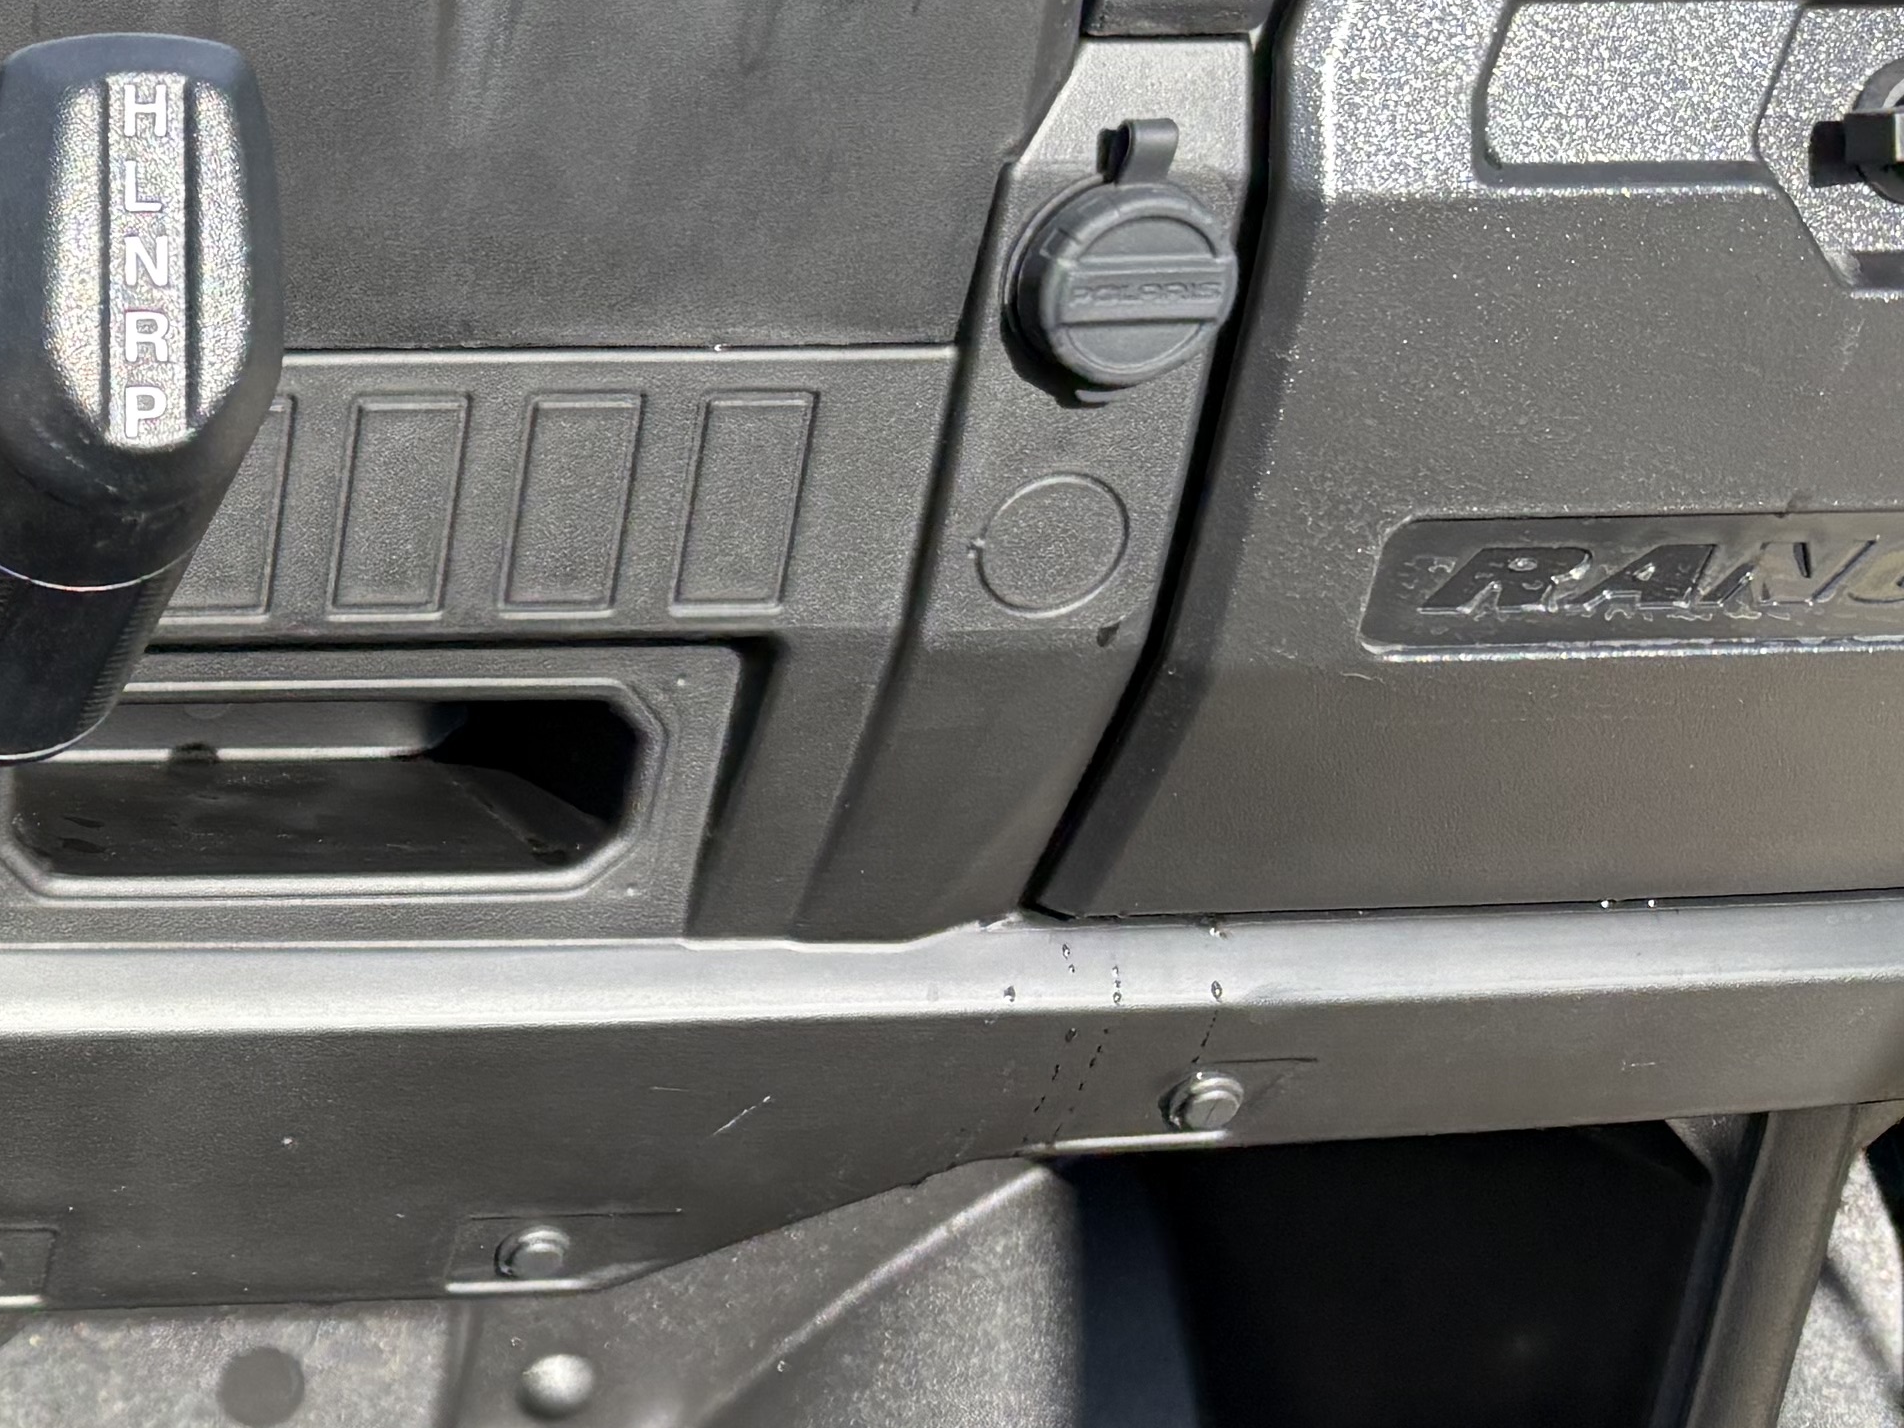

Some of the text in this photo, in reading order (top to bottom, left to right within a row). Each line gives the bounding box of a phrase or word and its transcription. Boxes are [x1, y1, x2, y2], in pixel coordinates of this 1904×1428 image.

[122, 83, 167, 137] H
[123, 160, 163, 214] L
[123, 235, 169, 287] N
[122, 311, 170, 363] R
[123, 386, 168, 438] P
